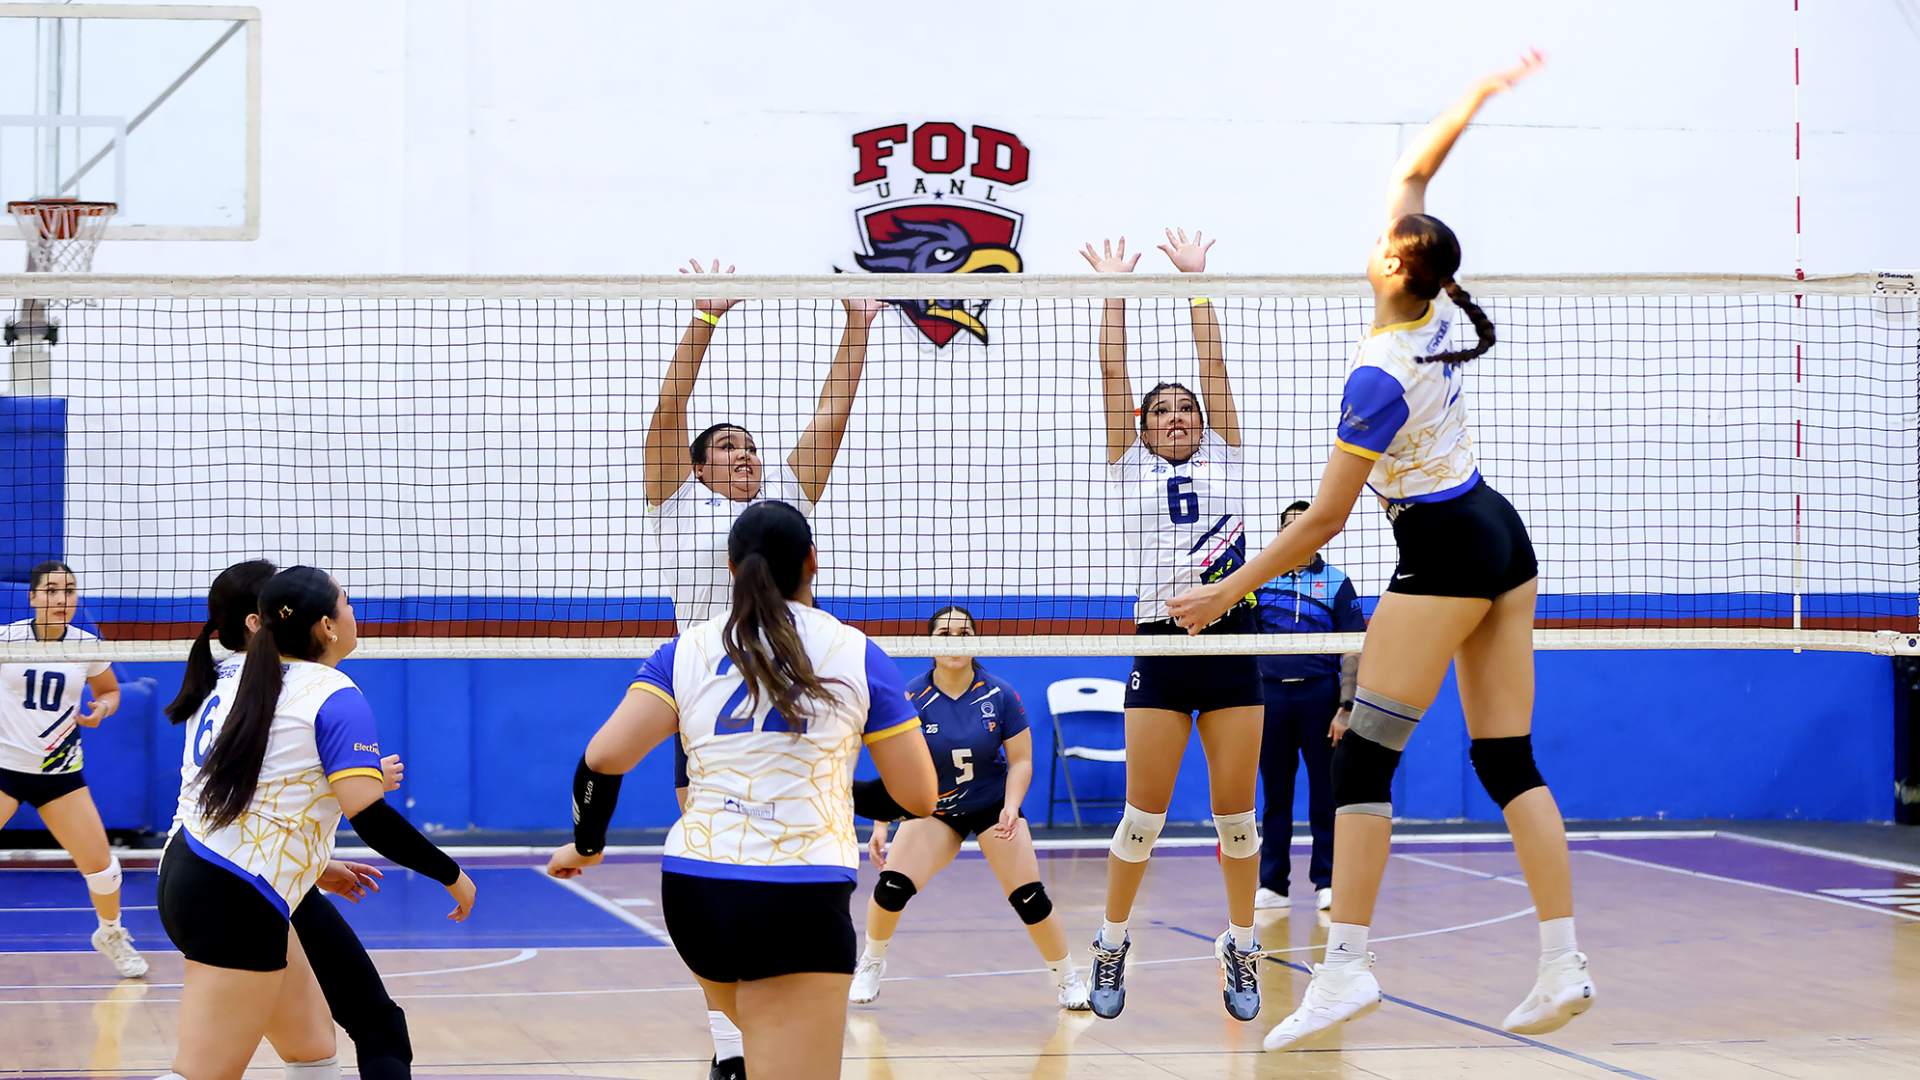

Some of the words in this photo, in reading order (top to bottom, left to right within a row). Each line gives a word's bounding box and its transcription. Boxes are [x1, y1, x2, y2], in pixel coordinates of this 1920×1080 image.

[852, 121, 1030, 186] FOD
[876, 178, 997, 201] UANL
[1167, 476, 1199, 524] 6
[22, 669, 66, 712] 10
[193, 695, 221, 768] 6
[951, 748, 974, 785] 5
